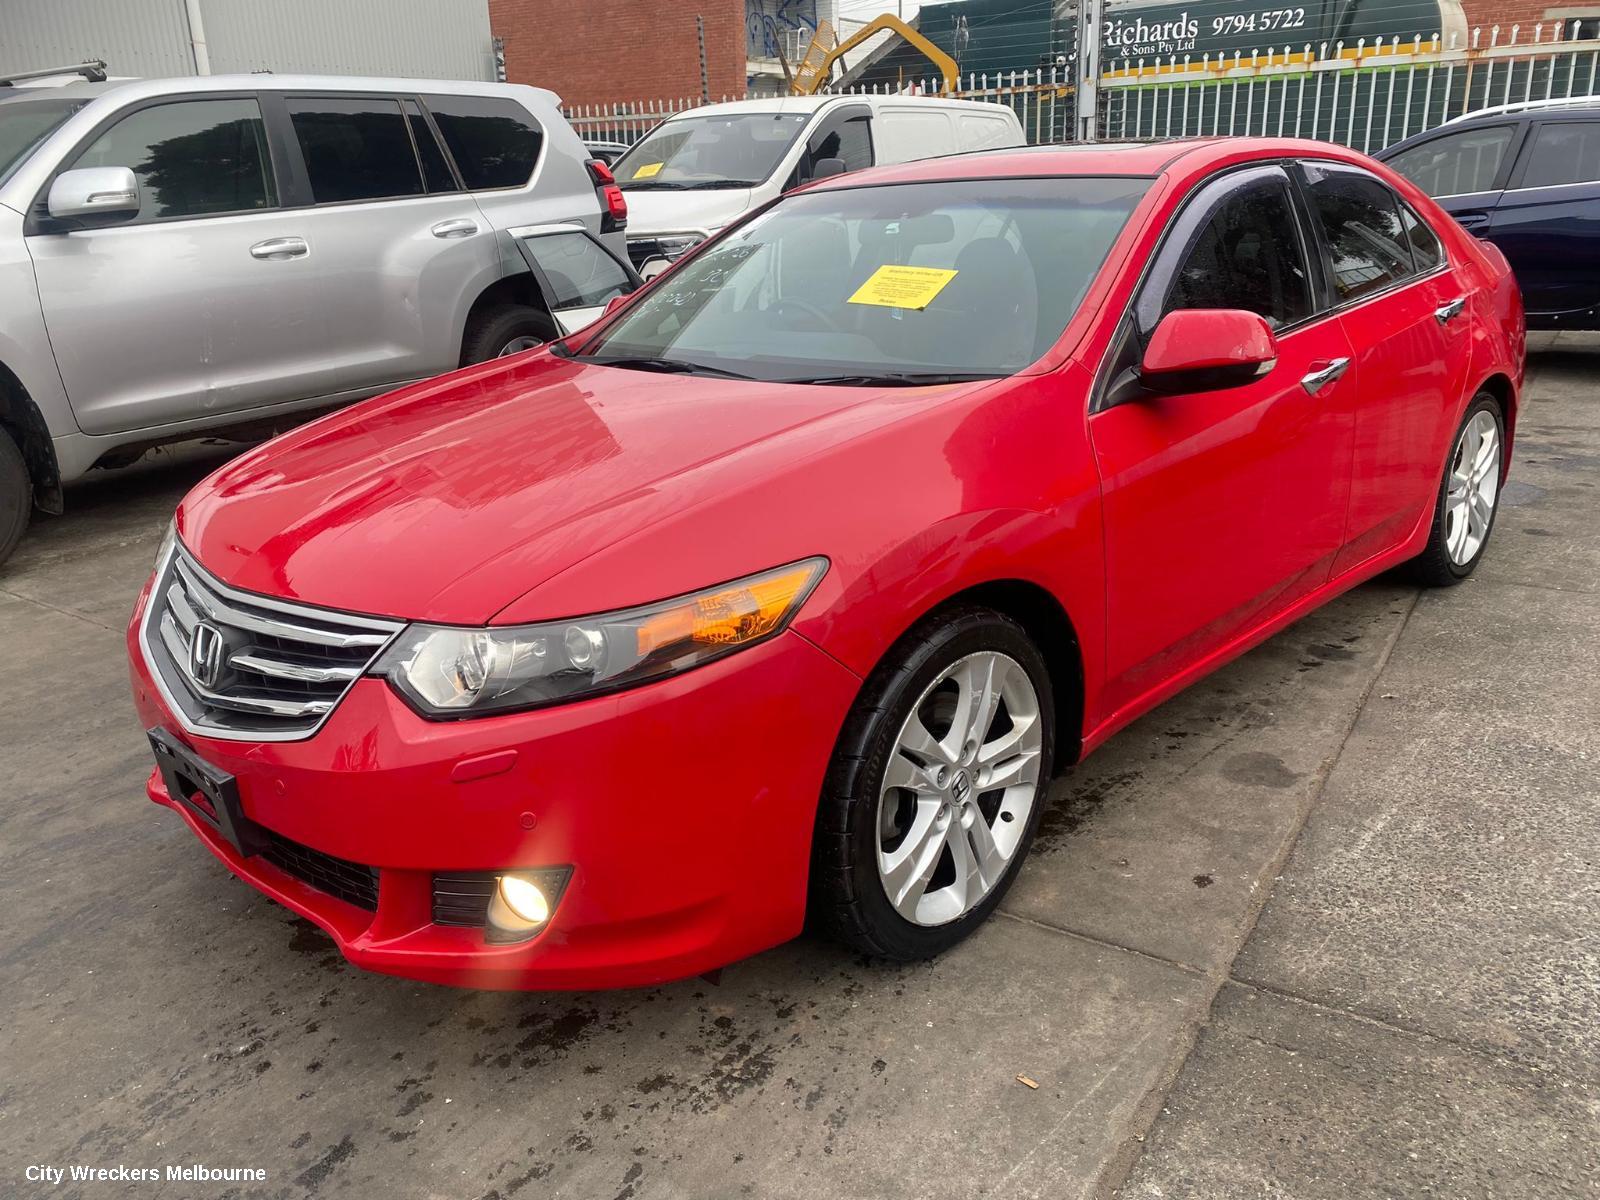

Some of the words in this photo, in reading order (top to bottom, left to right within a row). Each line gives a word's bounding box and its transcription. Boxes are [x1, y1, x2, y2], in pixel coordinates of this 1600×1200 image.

[1102, 12, 1199, 47] Richards
[1212, 15, 1256, 36] 9794
[1259, 8, 1305, 32] 5722
[1120, 45, 1131, 57] &
[1132, 44, 1156, 56] Sons
[1158, 41, 1175, 55] Pty
[1177, 39, 1196, 52] Ltd
